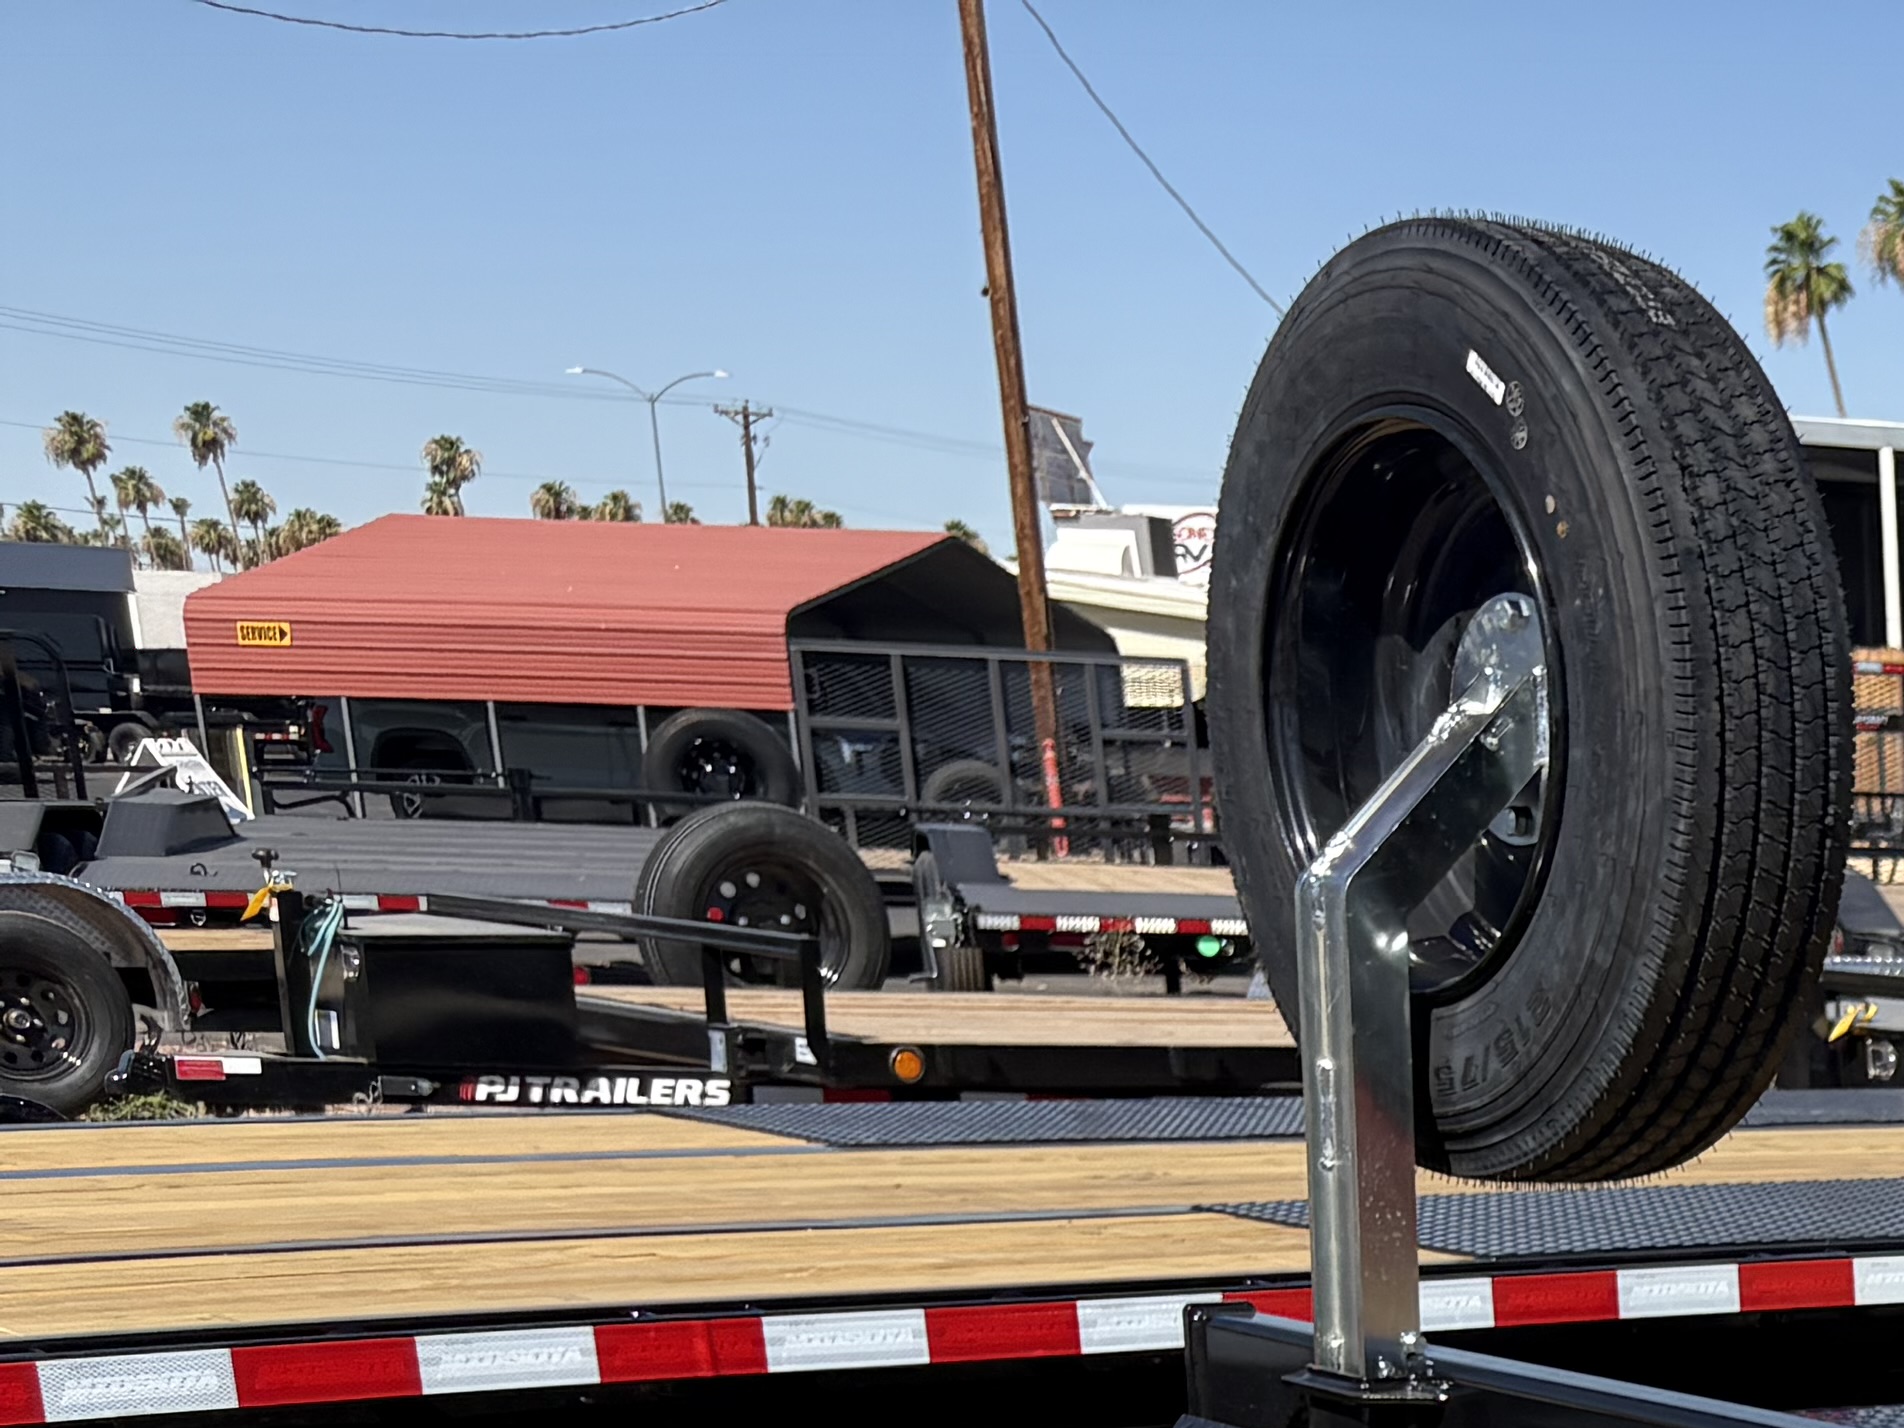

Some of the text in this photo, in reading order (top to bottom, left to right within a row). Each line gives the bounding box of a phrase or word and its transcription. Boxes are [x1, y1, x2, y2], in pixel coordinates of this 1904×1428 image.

[240, 625, 277, 641] SERVICE
[475, 1075, 731, 1106] PJ TRAILERS
